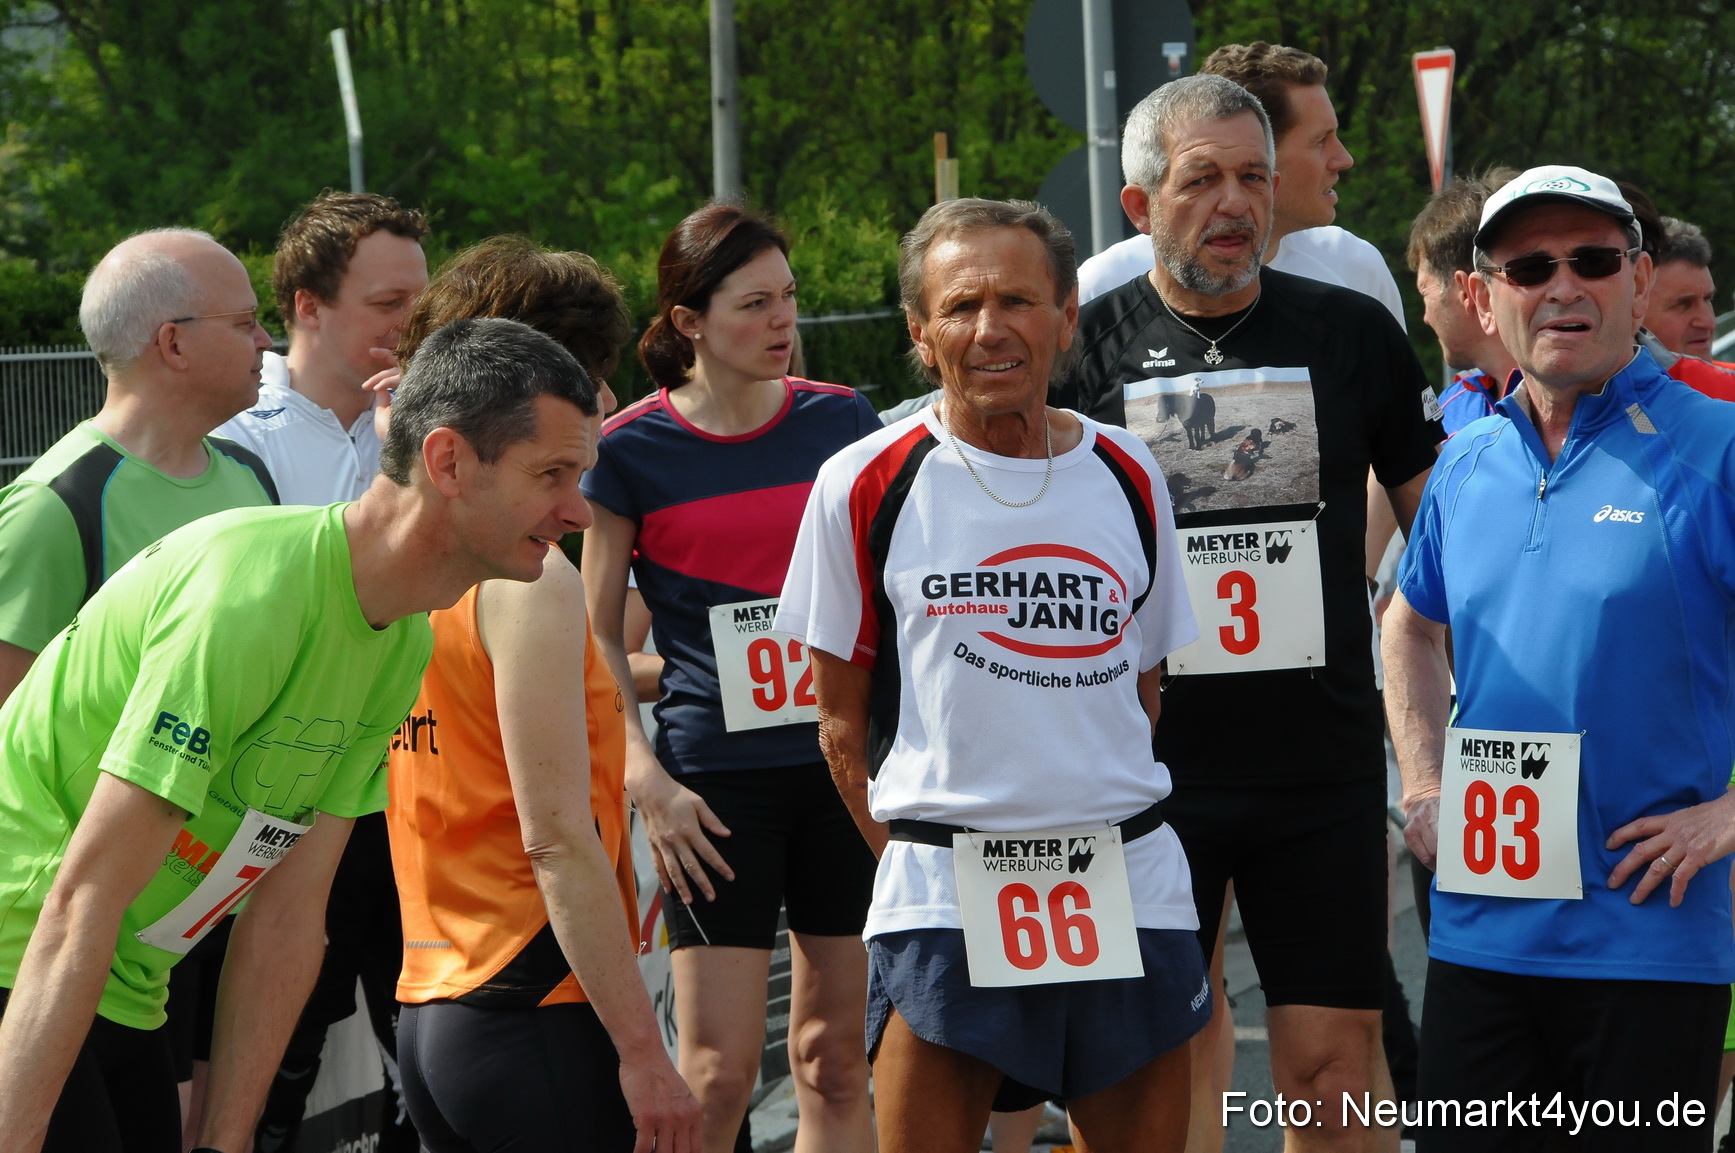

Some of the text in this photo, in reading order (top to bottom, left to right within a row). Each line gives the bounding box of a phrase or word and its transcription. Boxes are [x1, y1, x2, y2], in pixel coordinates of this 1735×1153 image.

[1142, 359, 1176, 368] erima
[1608, 508, 1645, 524] asics
[1186, 532, 1260, 552] MEYER
[1187, 550, 1262, 565] WERBUNG
[922, 572, 1120, 604] GERHART &
[926, 602, 1008, 617] Autohaus
[1007, 602, 1119, 636] JÄNIG
[1217, 570, 1260, 656] 3
[747, 638, 818, 712] 92
[953, 642, 1130, 688] Das sportliche Autohaus
[153, 711, 210, 760] FeB
[148, 736, 179, 756] Fenster
[180, 752, 198, 764] und
[1460, 738, 1516, 760] MEYER
[1460, 758, 1516, 774] WERBUNG
[1464, 780, 1540, 880] 83
[982, 838, 1063, 858] MEYER
[982, 858, 1064, 872] WERBUNG
[997, 880, 1100, 970] 66
